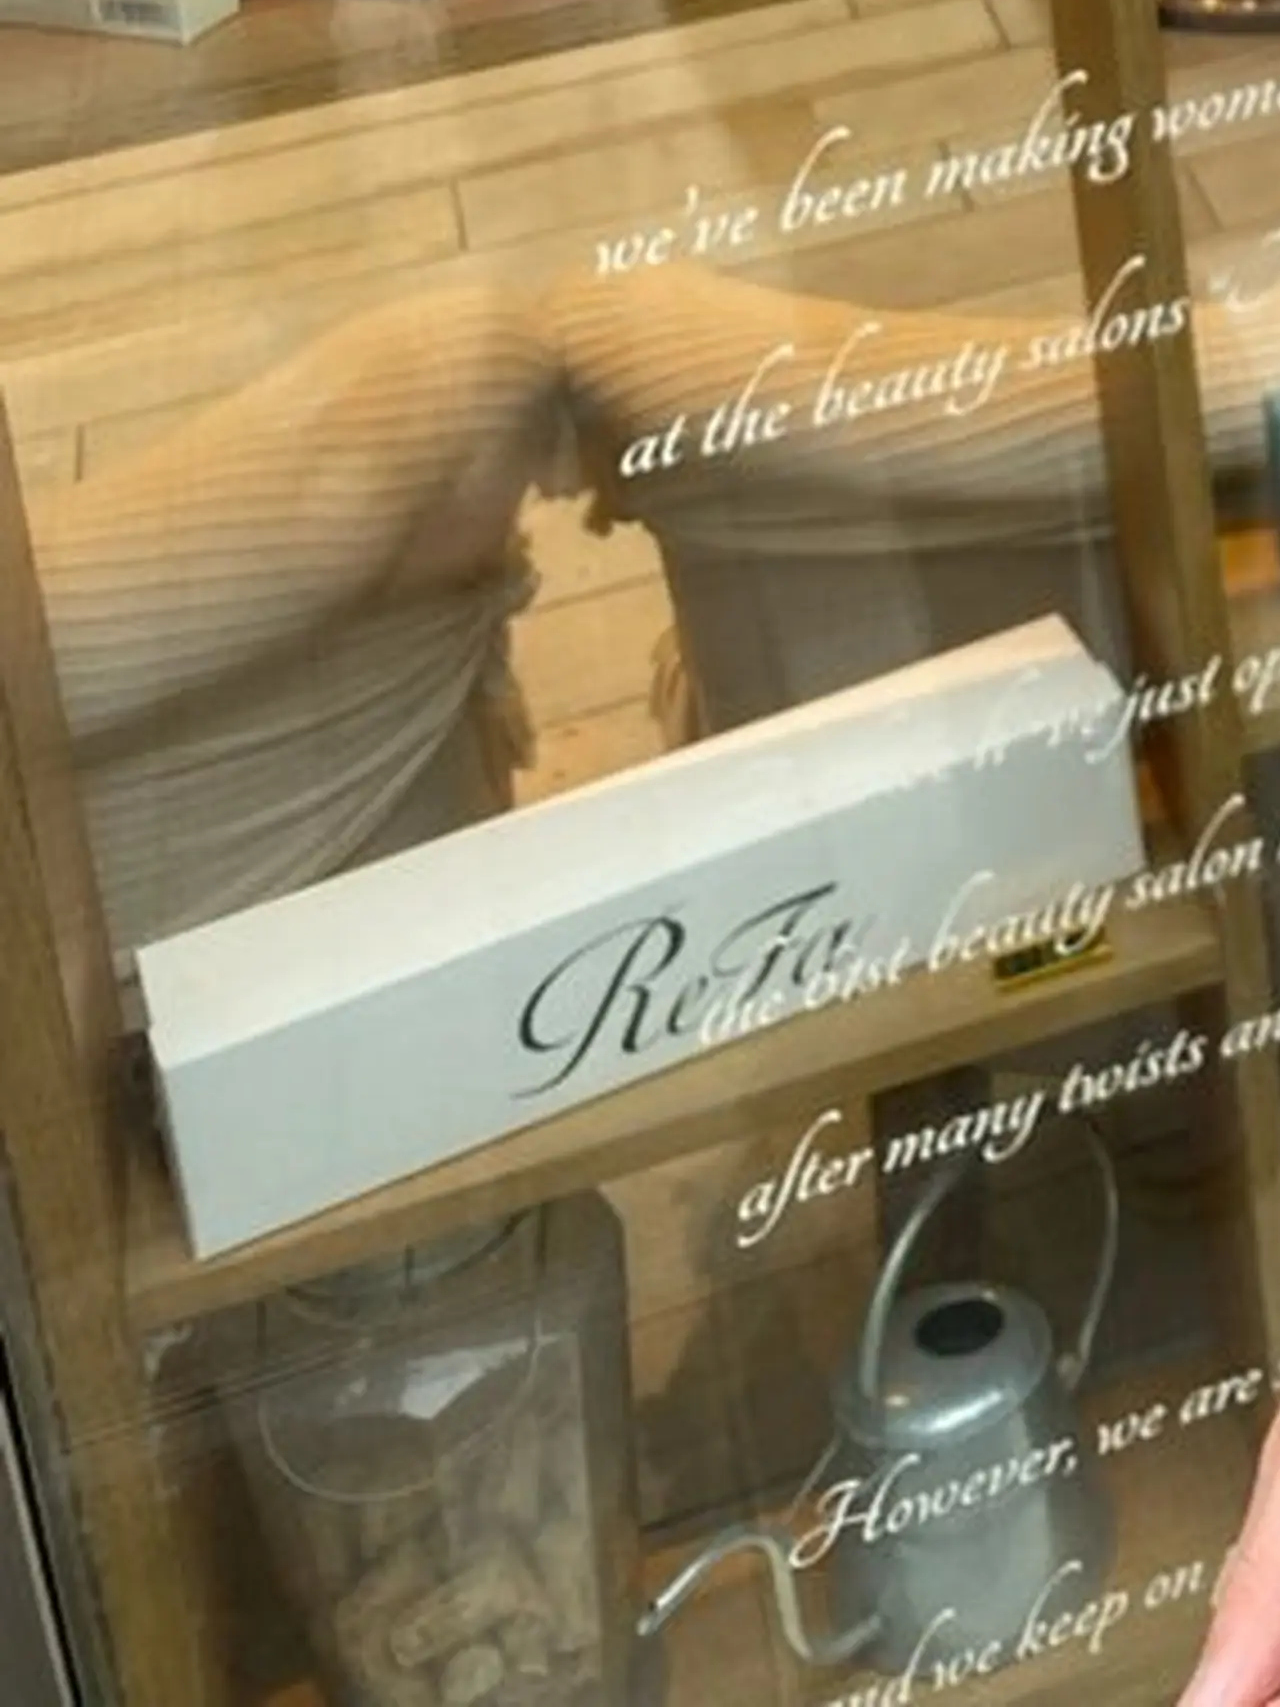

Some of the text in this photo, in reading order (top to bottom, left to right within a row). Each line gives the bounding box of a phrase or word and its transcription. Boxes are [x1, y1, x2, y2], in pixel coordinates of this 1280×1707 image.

[594, 184, 759, 278] we've
[779, 126, 909, 235] been
[925, 70, 1137, 184] making
[618, 413, 691, 479] at
[699, 344, 795, 457] the
[812, 322, 1009, 428] beauty
[1022, 255, 1190, 370] salons
[1083, 654, 1223, 765] just
[928, 869, 1114, 972] beauty
[1124, 792, 1264, 910] salon
[737, 1109, 873, 1248] after
[883, 1089, 1044, 1163] many
[1056, 1027, 1208, 1115] twists
[789, 1453, 1081, 1571] However,
[1095, 1403, 1167, 1457] we
[1179, 1367, 1263, 1425] are
[930, 1639, 1002, 1690] we
[1016, 1559, 1129, 1660] keep
[1143, 1561, 1206, 1609] on
